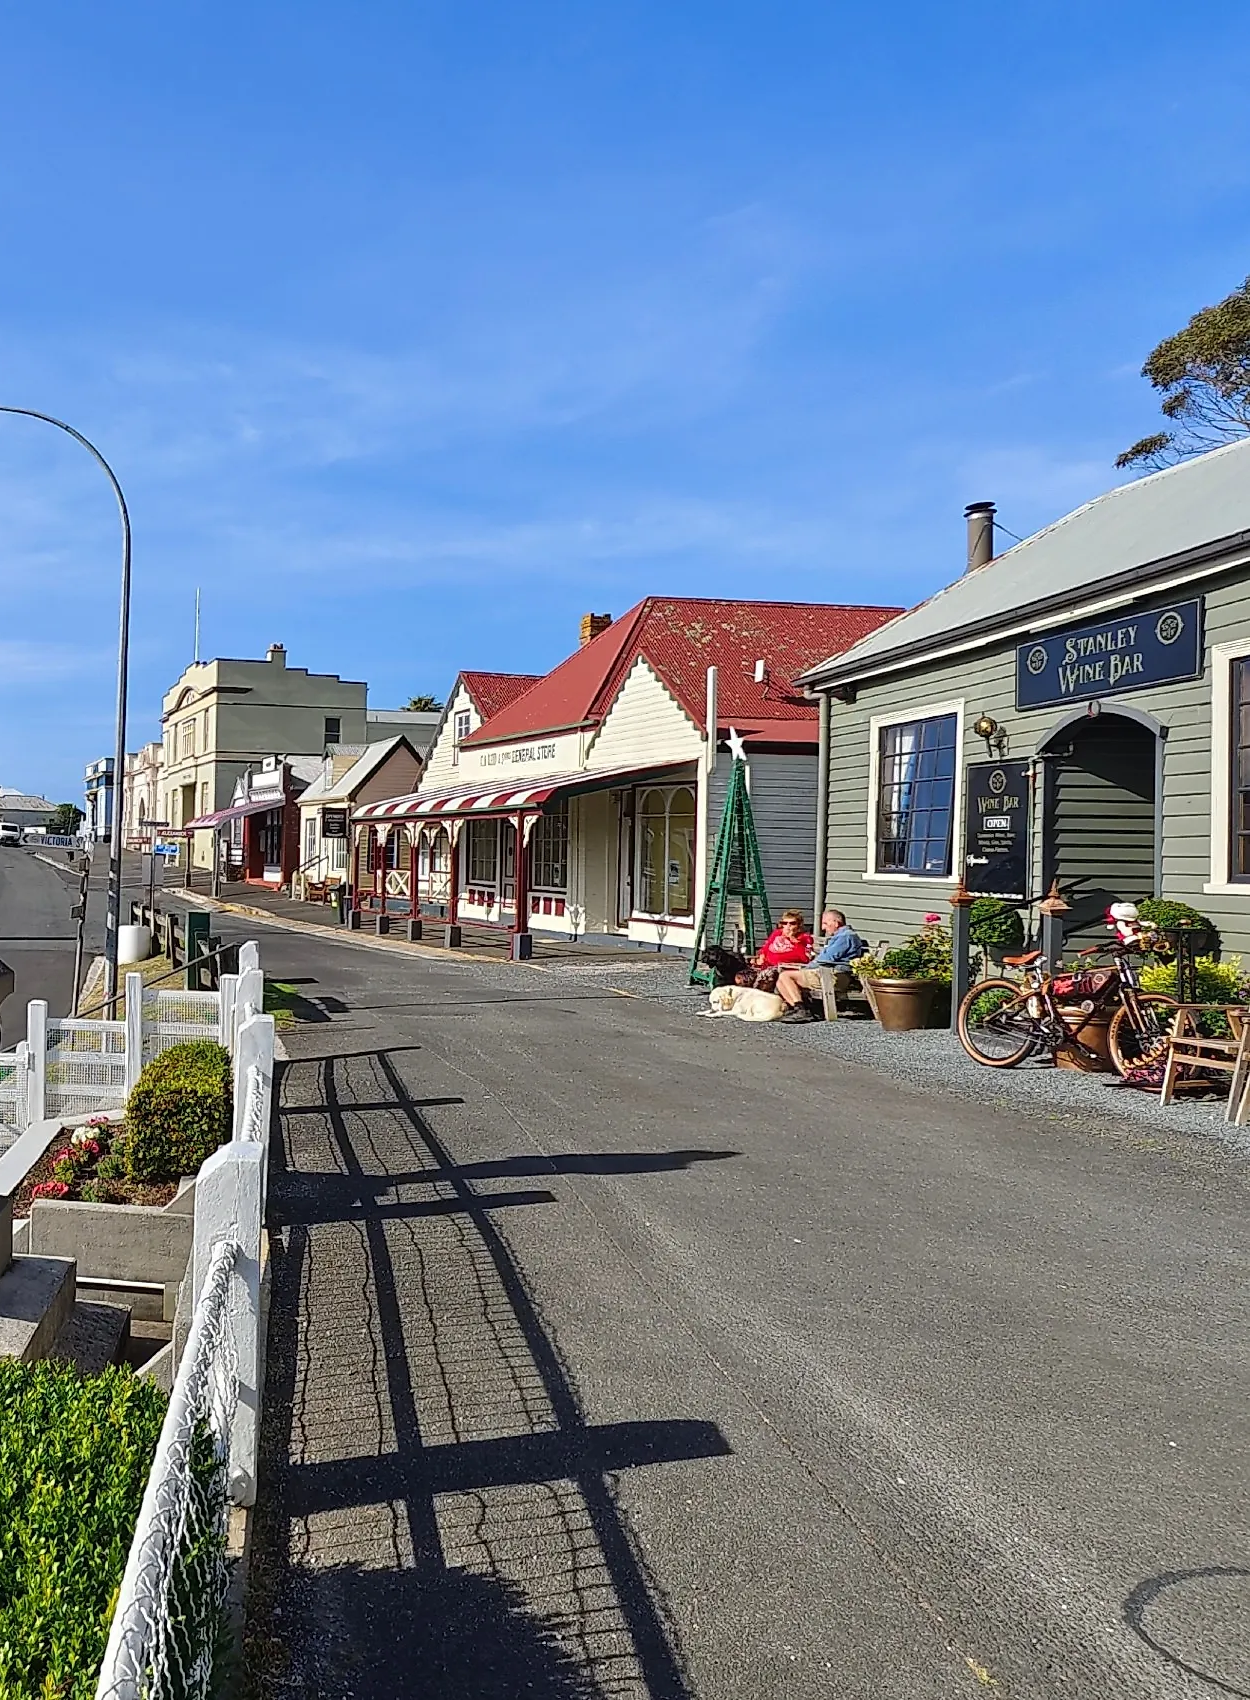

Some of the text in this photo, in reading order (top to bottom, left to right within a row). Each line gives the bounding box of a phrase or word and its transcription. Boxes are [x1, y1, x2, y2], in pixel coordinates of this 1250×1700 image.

[1062, 625, 1138, 665] STANLEY
[1058, 652, 1144, 695] WINE BAR
[977, 795, 1019, 814] WINE BAR
[987, 818, 1007, 828] OPEN
[40, 836, 73, 847] VICTORIA
